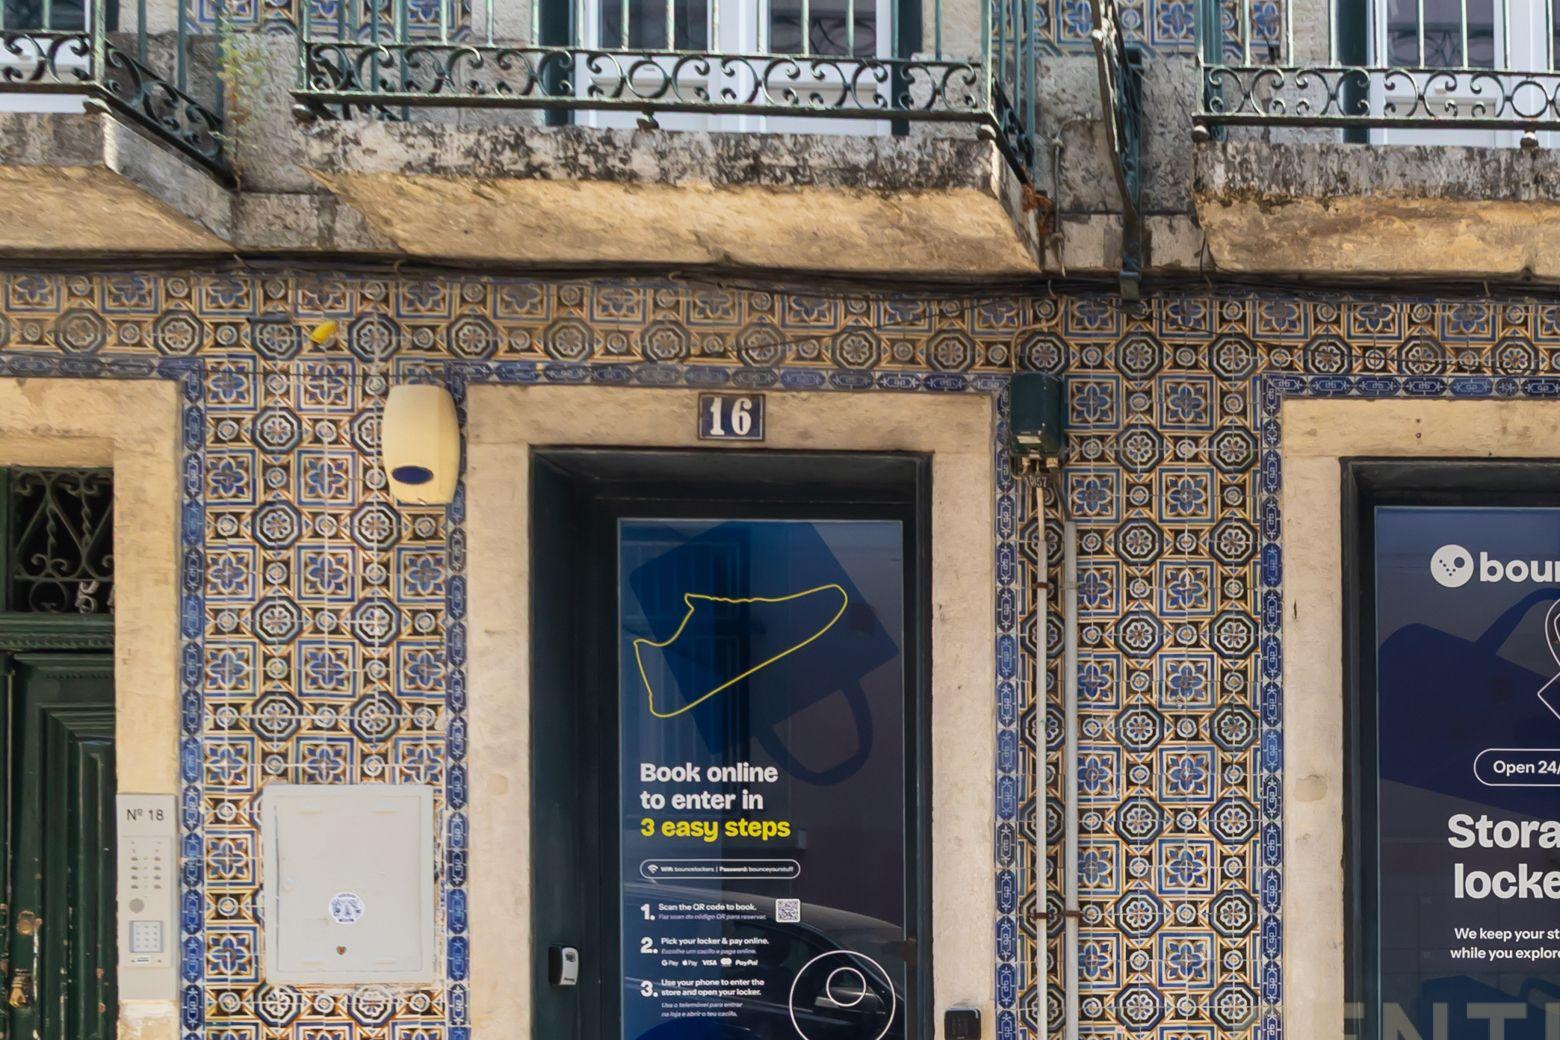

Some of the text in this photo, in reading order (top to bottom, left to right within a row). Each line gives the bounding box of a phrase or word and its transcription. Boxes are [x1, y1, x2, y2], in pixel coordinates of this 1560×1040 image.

[710, 398, 749, 436] 16
[641, 762, 778, 782] Book online
[1494, 760, 1534, 776] Open
[640, 790, 763, 809] to enter in
[149, 808, 164, 821] 18
[641, 818, 790, 842] 3 easy steps
[640, 904, 656, 920] 1.
[658, 903, 678, 911] Scan
[678, 903, 692, 911] the
[692, 903, 705, 911] QR
[705, 903, 725, 911] code
[735, 903, 757, 911] book.
[661, 937, 678, 945] Pick
[697, 937, 720, 945] locker
[743, 937, 770, 945] online.
[1455, 928, 1476, 939] We
[1480, 928, 1512, 942] keep
[1515, 931, 1544, 942] your
[641, 937, 658, 954] 2.
[1450, 947, 1484, 958] while
[1481, 950, 1512, 961] you
[641, 981, 658, 997] 3.
[695, 979, 720, 987] phone
[736, 988, 762, 996] locker.
